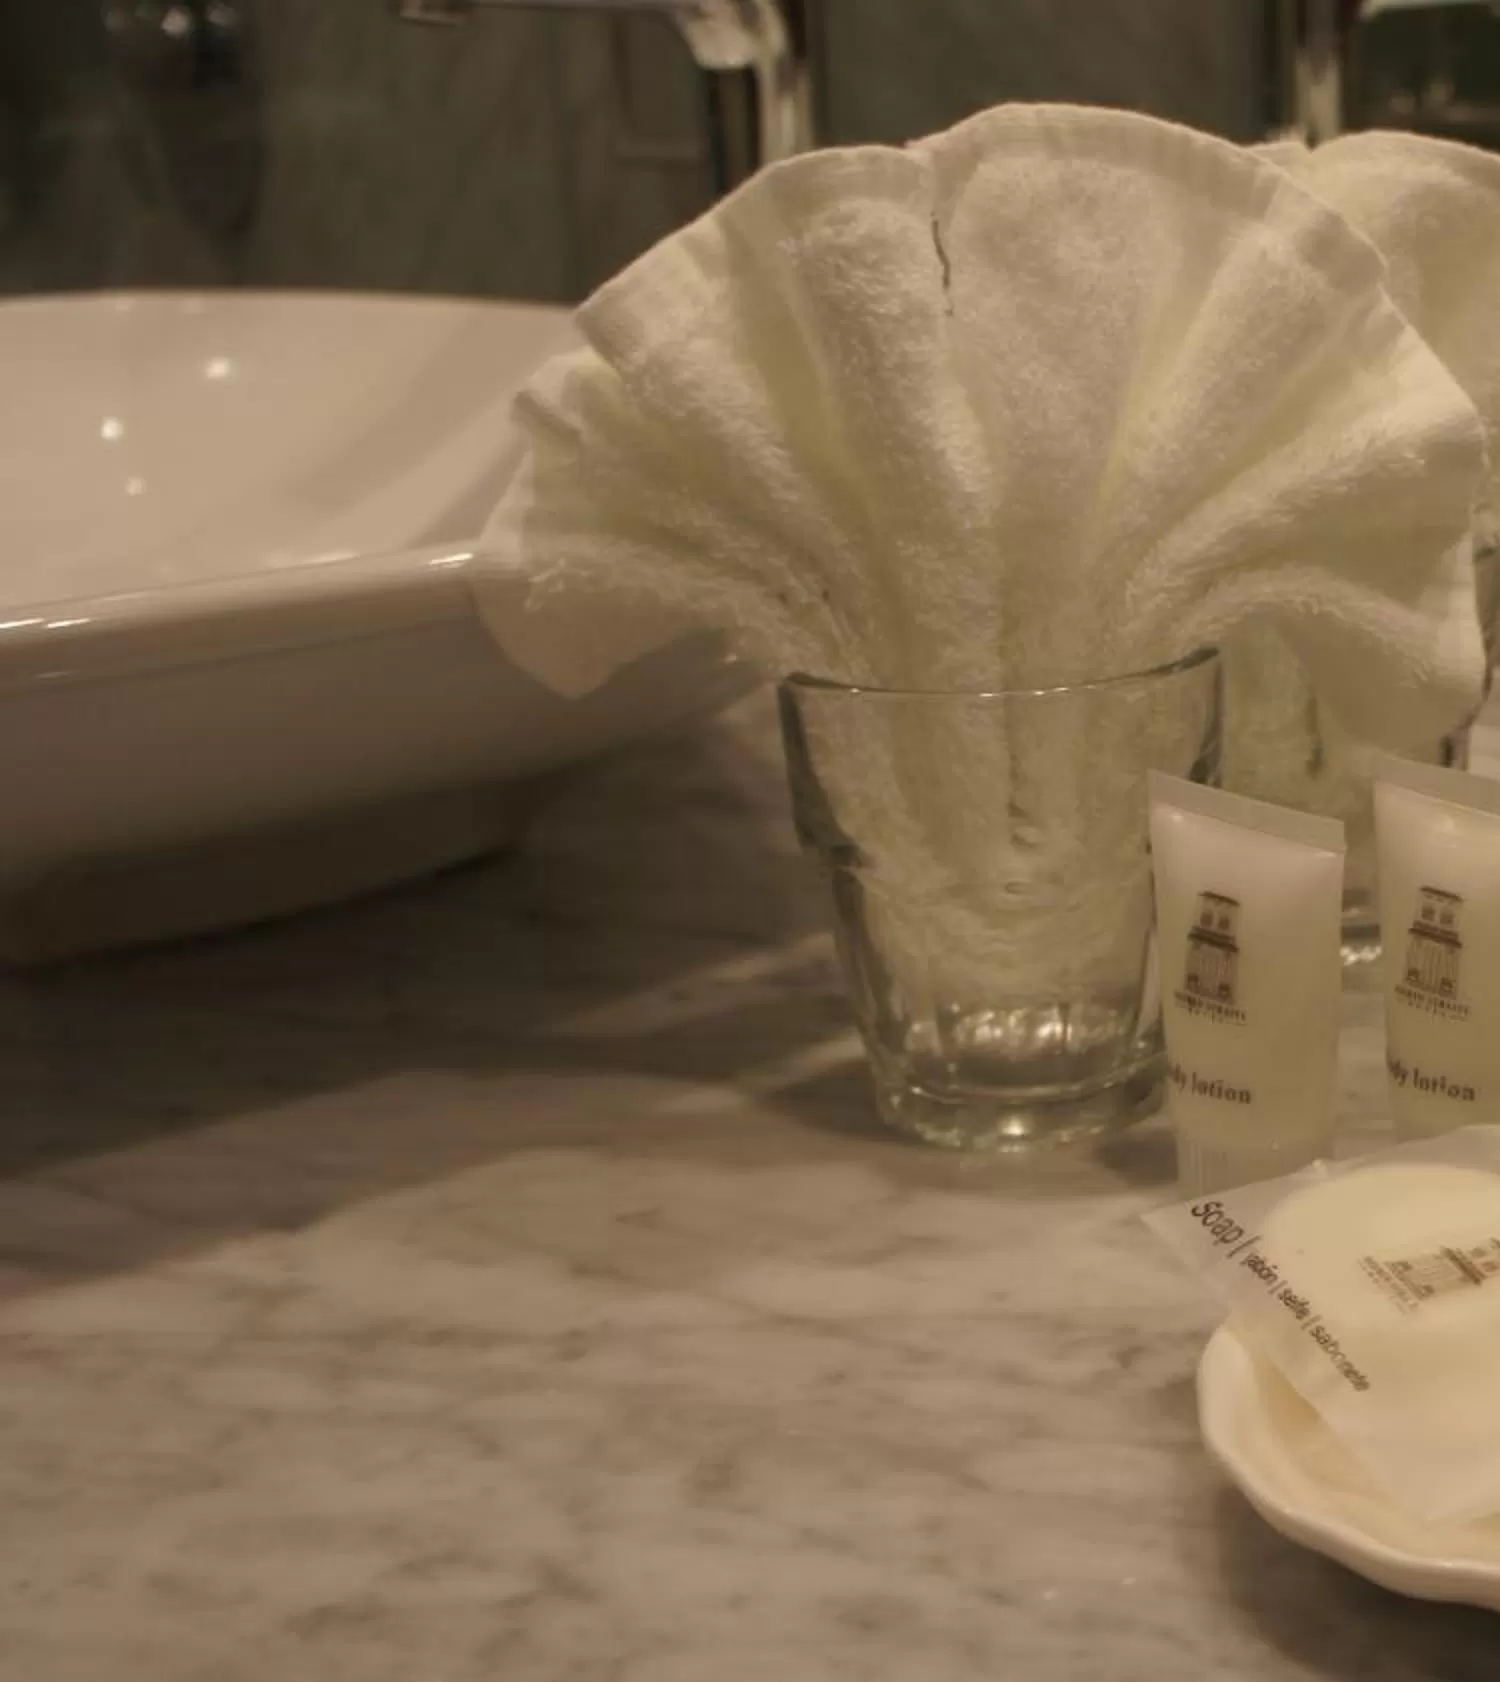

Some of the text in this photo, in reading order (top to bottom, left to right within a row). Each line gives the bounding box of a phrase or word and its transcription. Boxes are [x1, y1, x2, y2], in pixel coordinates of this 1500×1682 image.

[1191, 1071, 1251, 1105] lotion
[1413, 1067, 1475, 1101] lotion
[1191, 1201, 1245, 1246] Soap
